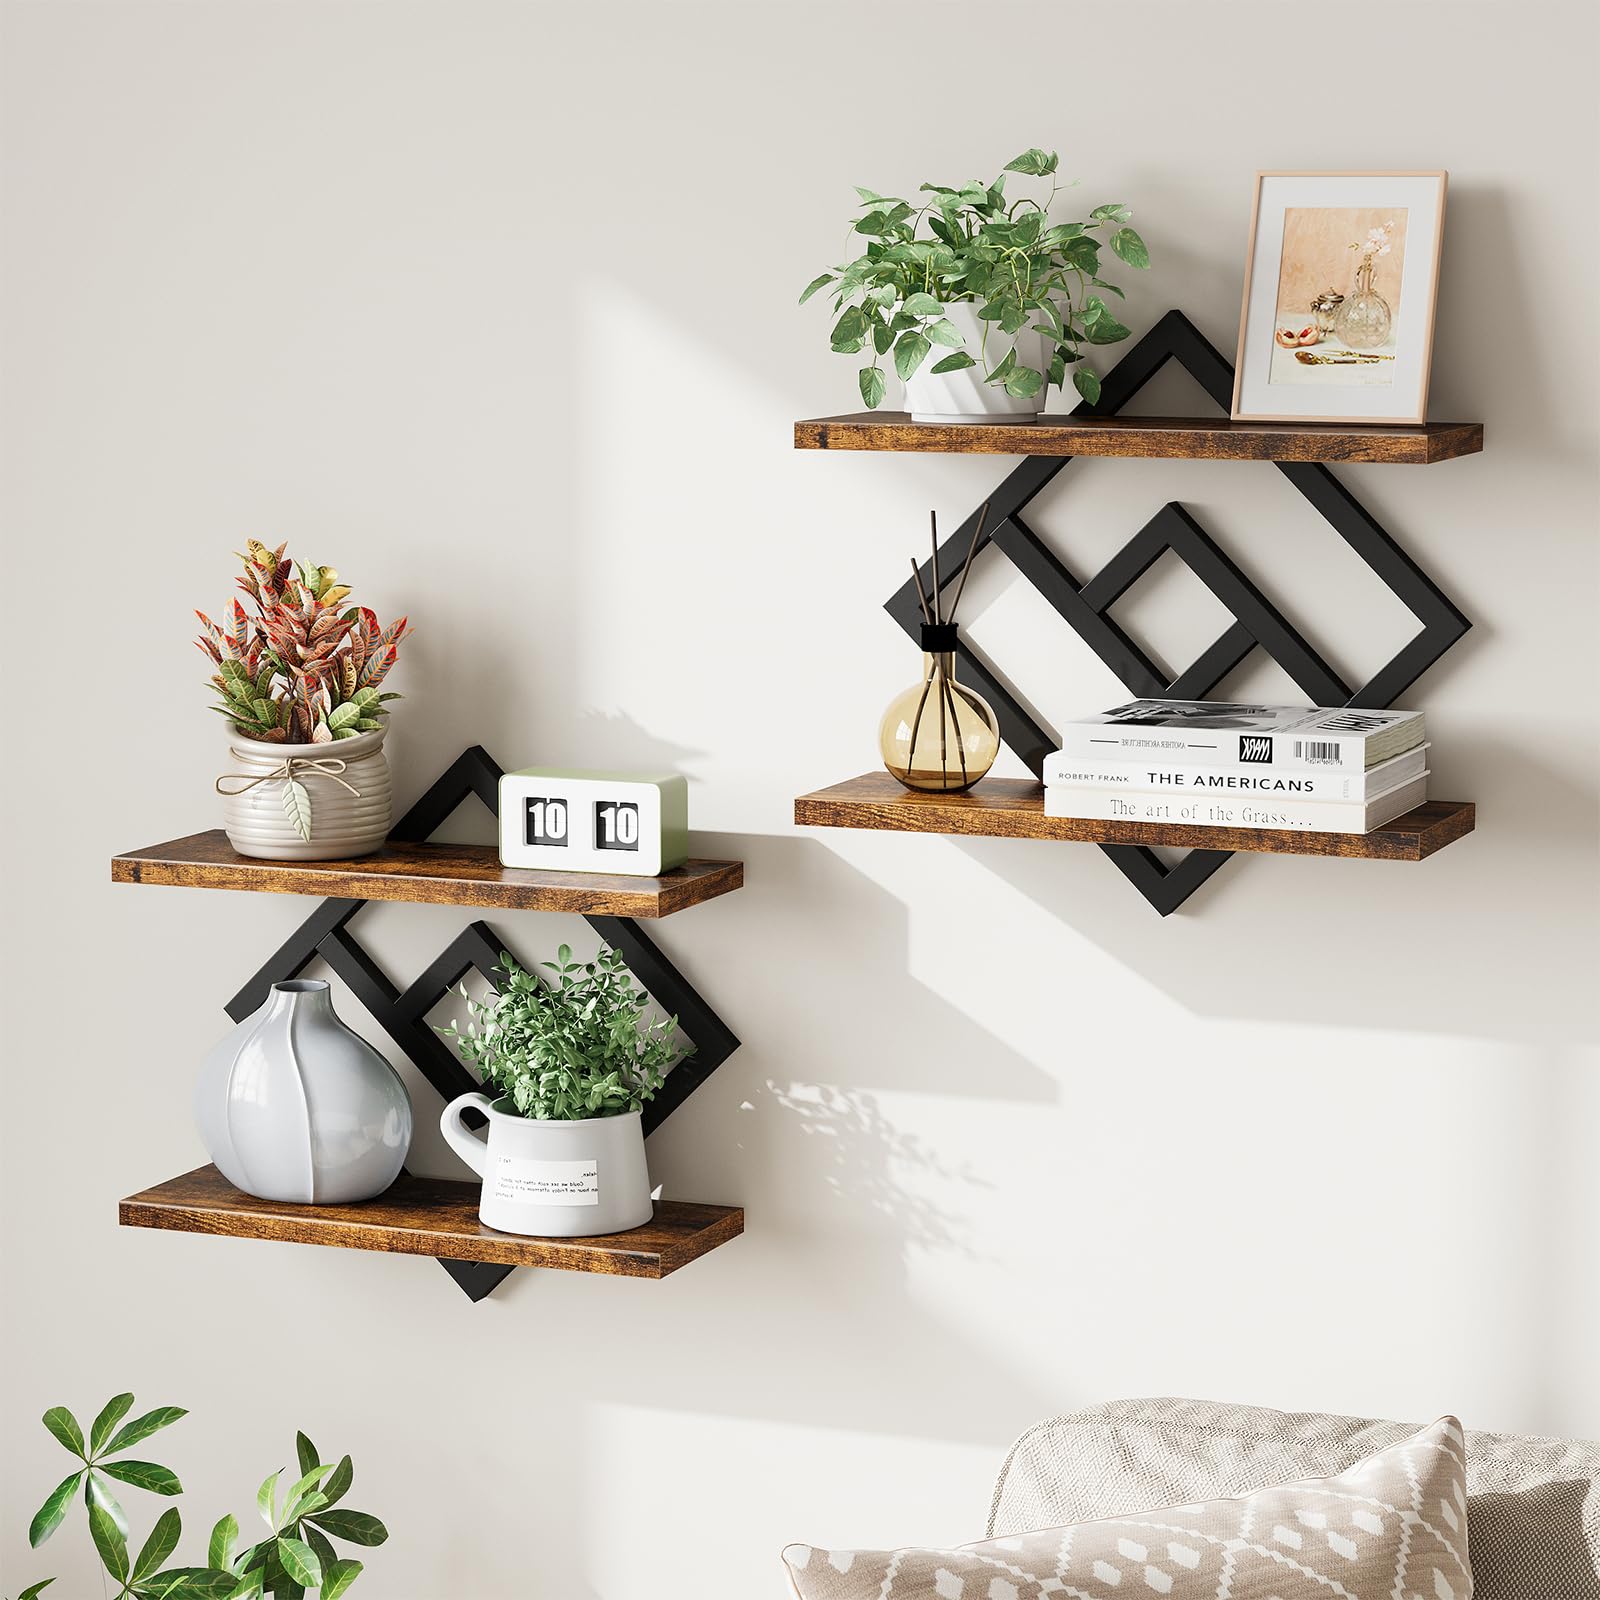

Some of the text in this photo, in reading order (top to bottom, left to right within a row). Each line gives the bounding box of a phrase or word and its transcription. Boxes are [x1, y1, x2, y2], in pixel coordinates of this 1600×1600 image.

[1058, 772, 1130, 784] ROBERT FRANK
[1147, 772, 1315, 793] THE AMERICANS
[528, 802, 638, 844] 10 10
[1110, 799, 1313, 827] The art of the Grass...
